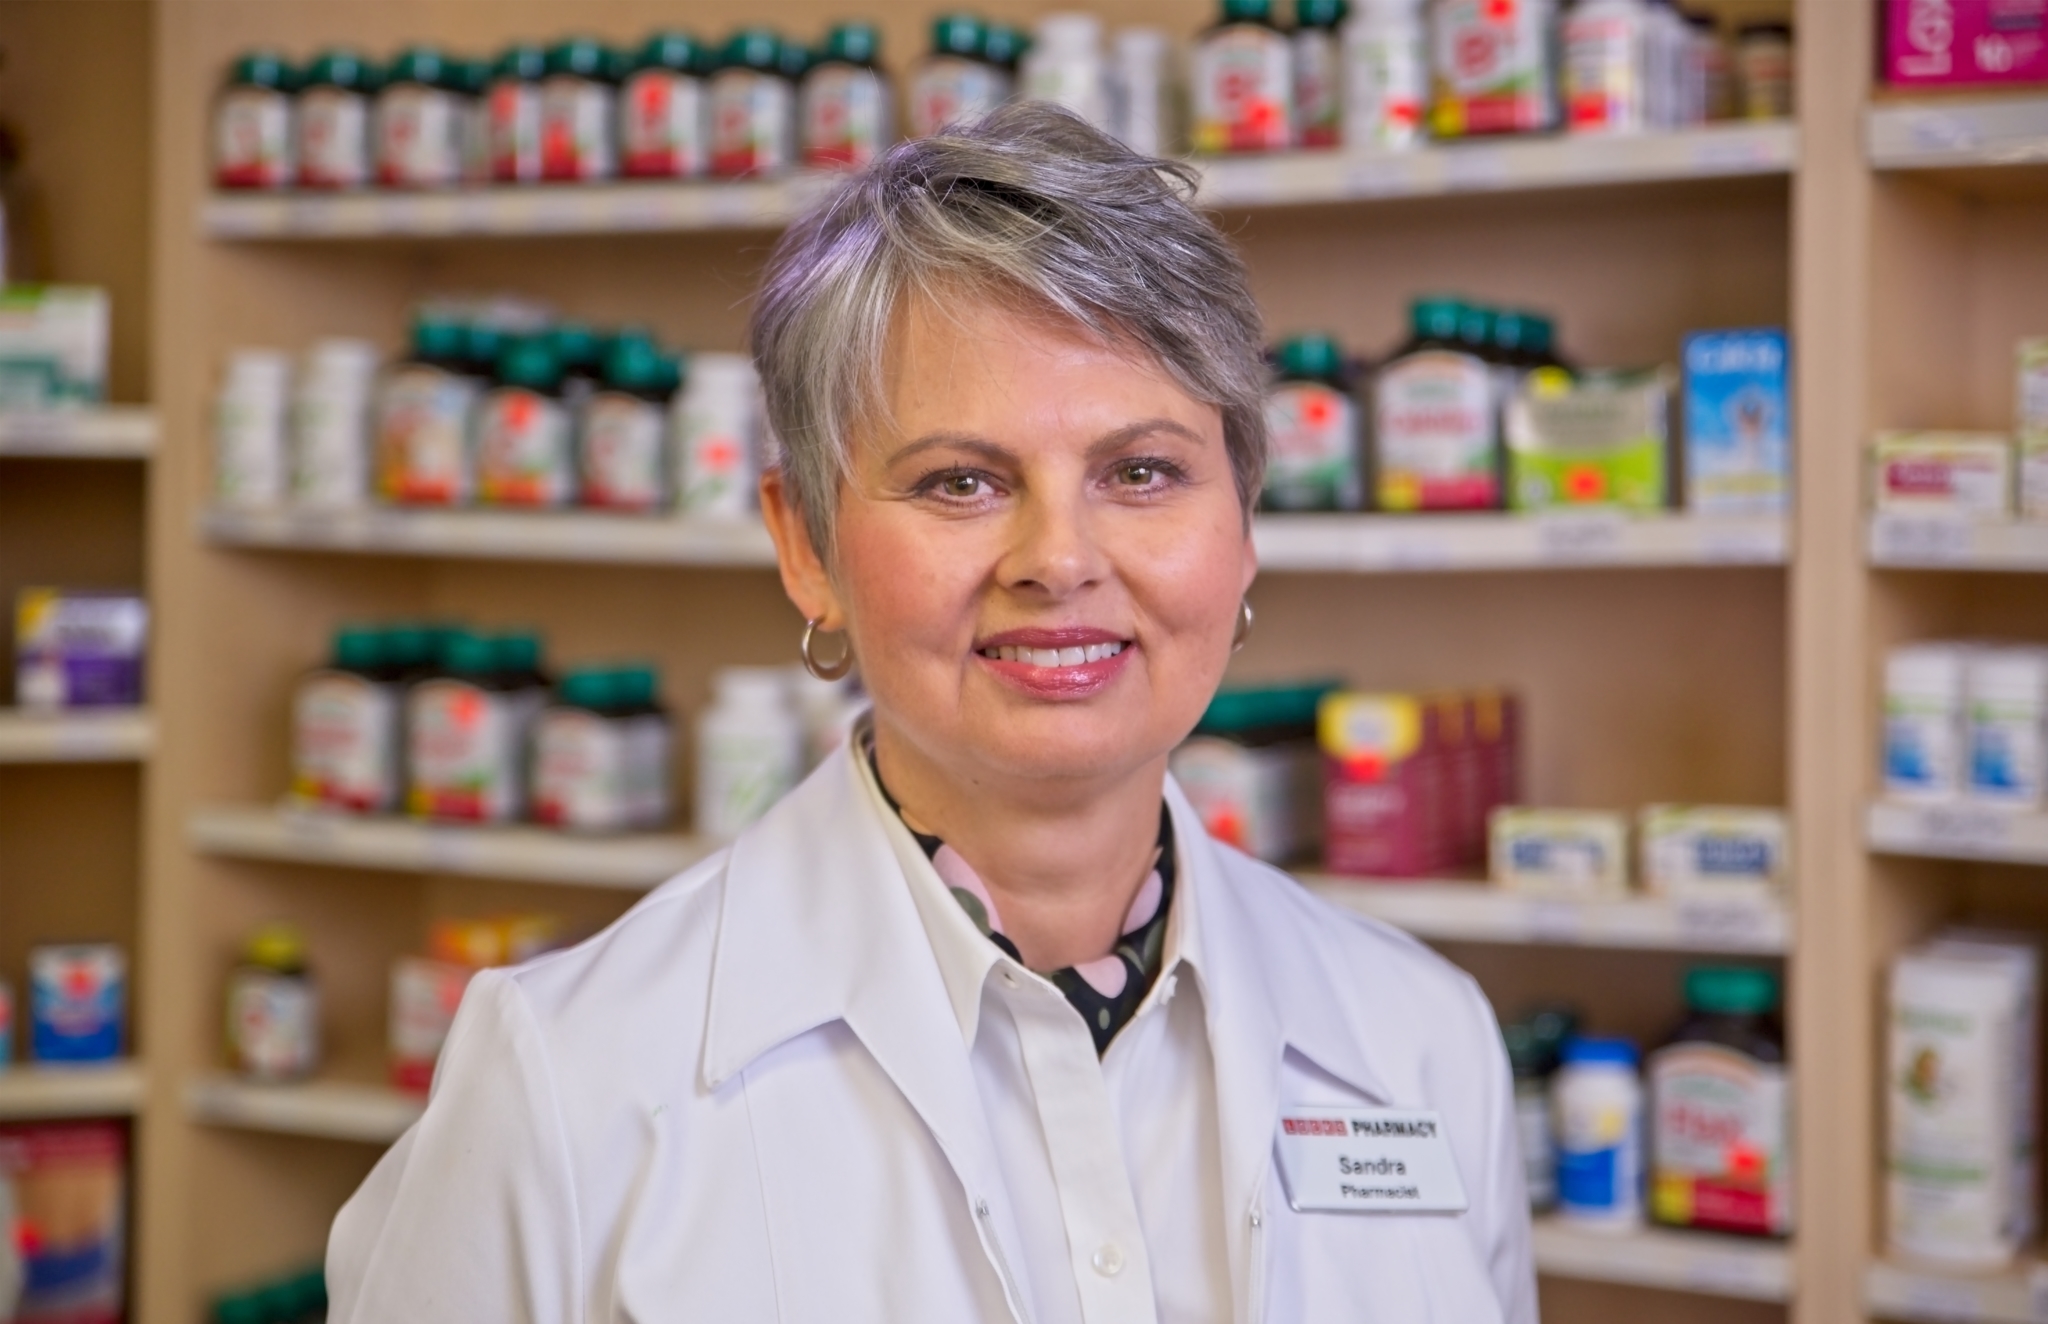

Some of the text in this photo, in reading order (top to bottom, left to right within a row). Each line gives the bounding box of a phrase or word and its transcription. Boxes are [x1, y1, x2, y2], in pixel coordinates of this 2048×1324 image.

[1351, 1120, 1437, 1138] PHARMACY
[1338, 1155, 1407, 1176] Sandra
[1340, 1184, 1421, 1200] Pharmacist
